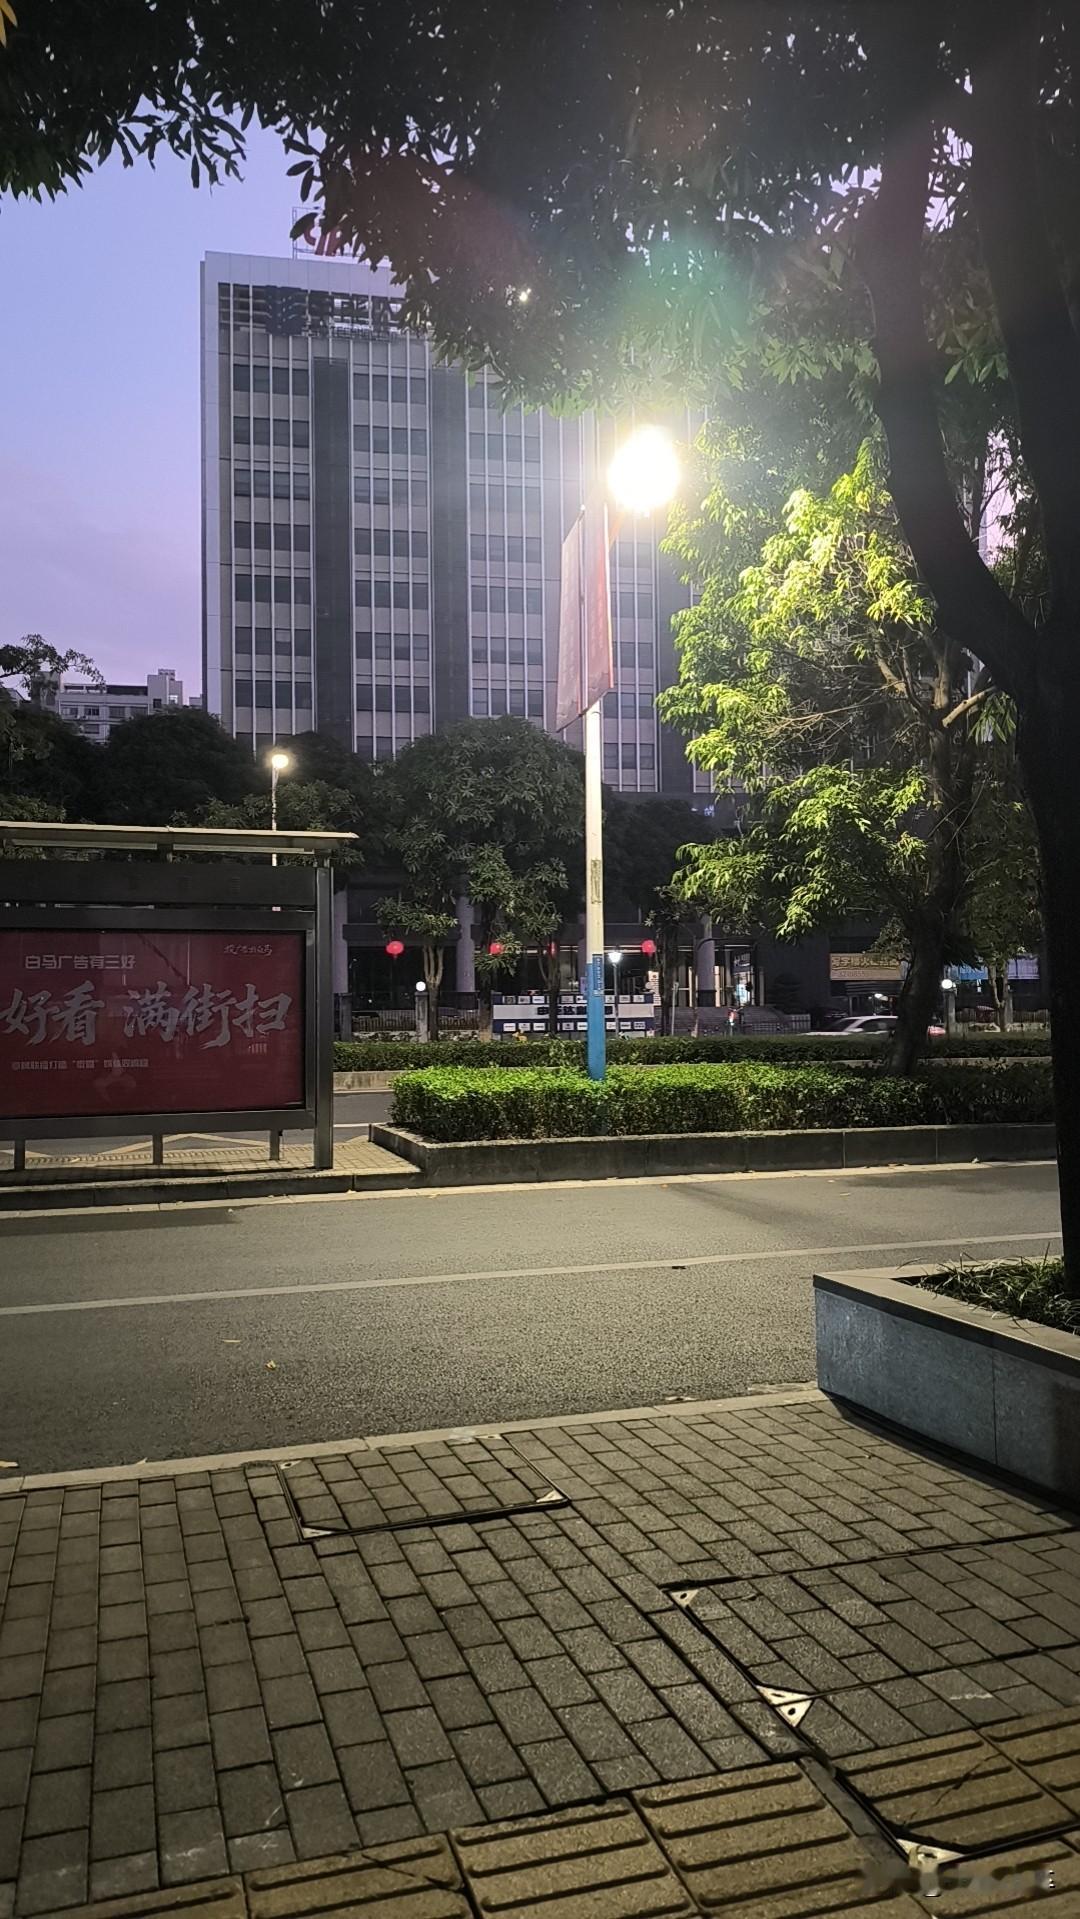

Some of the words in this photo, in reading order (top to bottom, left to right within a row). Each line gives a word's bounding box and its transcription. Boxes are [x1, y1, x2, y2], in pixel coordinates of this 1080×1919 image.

[25, 954, 137, 970] 白马广告有三好
[0, 980, 105, 1046] 好看
[123, 980, 293, 1049] 满街扫
